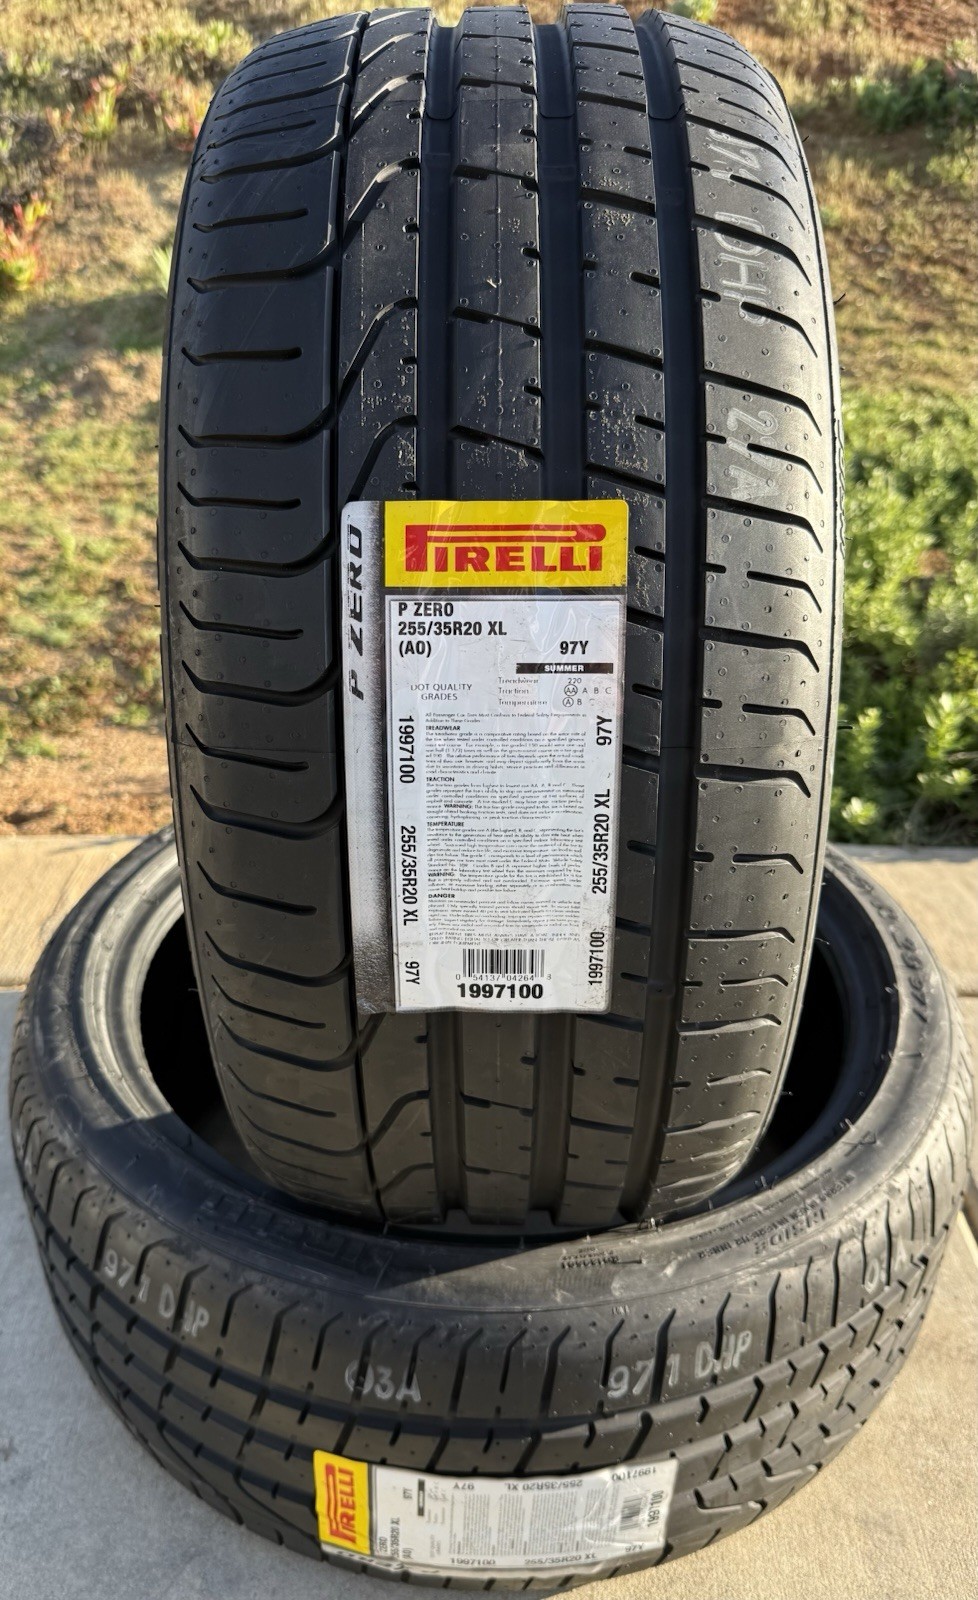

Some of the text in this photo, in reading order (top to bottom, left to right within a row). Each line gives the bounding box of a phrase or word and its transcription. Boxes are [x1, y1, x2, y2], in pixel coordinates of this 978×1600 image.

[405, 524, 606, 572] PIRELLI
[348, 524, 364, 700] P ZERO
[398, 602, 454, 616] P ZERO
[398, 621, 507, 636] 255/35R20 XL
[559, 641, 589, 655] 97Y
[421, 693, 458, 701] GRADES
[433, 683, 472, 691] QUALITY
[596, 715, 612, 746] 97Y
[398, 716, 415, 784] 1997100
[592, 788, 610, 894] 255/35R20 XL
[400, 825, 418, 926] 255/35R20 XL
[588, 931, 605, 986] 1997100
[405, 961, 420, 985] 97Y
[455, 973, 461, 981] 0
[506, 974, 535, 982] 04264
[457, 983, 543, 999] 1997100
[606, 1353, 681, 1398] 971
[453, 1482, 475, 1490] 97Y
[325, 1463, 357, 1544] PIRELLI
